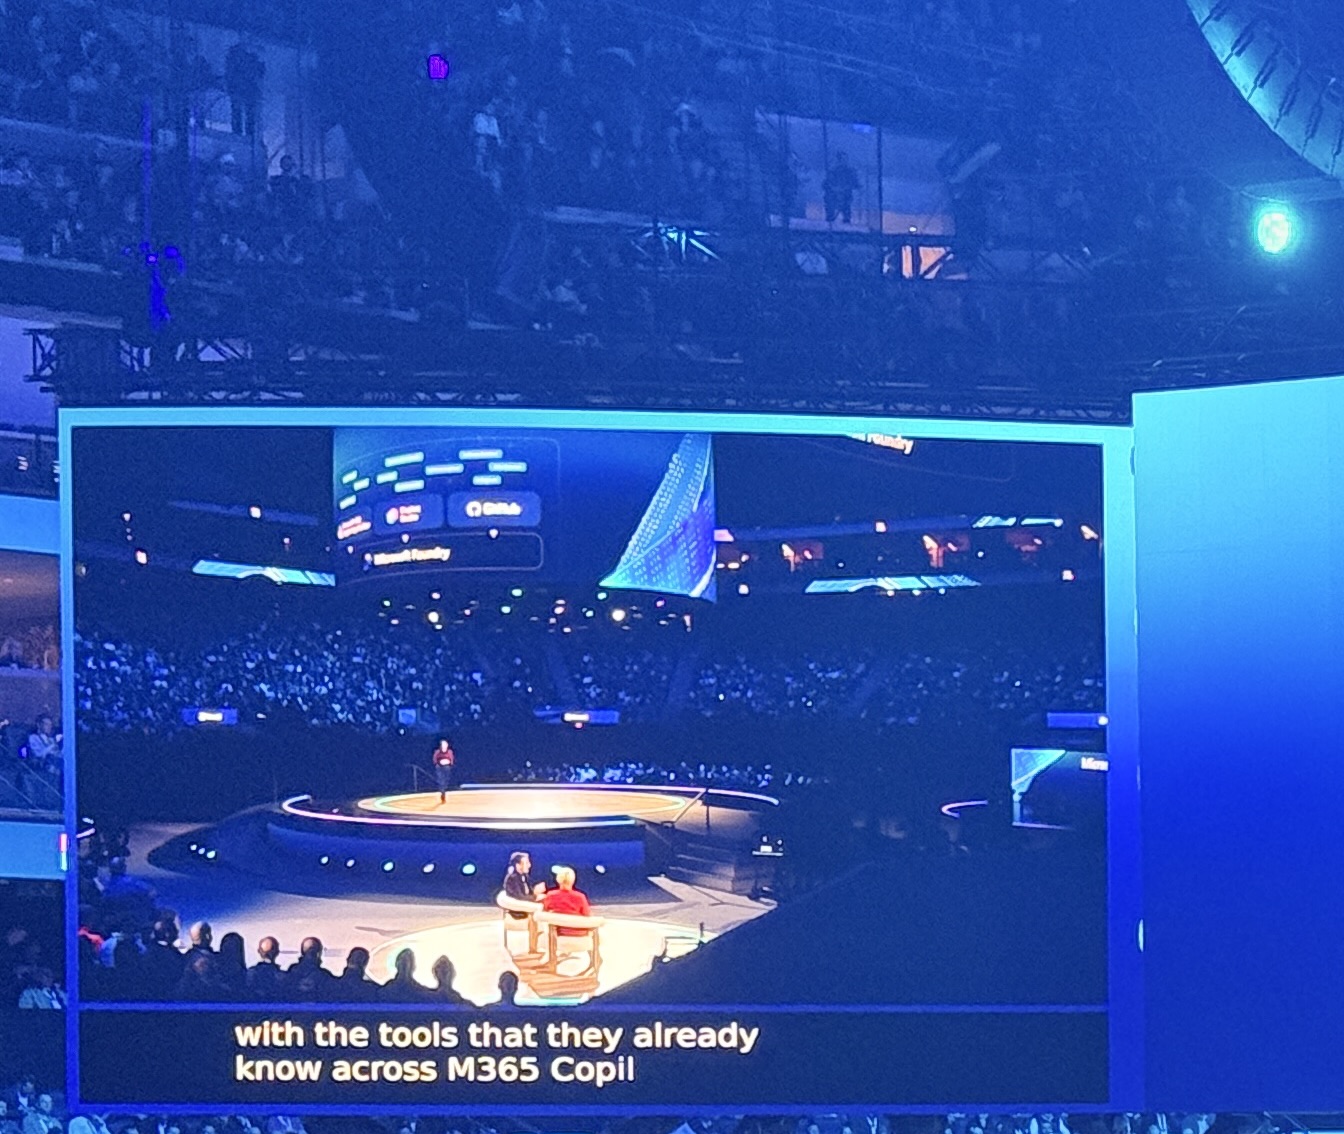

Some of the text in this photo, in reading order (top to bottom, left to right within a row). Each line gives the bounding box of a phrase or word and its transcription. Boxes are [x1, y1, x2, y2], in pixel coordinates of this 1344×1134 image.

[234, 1020, 759, 1054] with the tools that they already
[235, 1054, 635, 1088] know across M365 Copil
